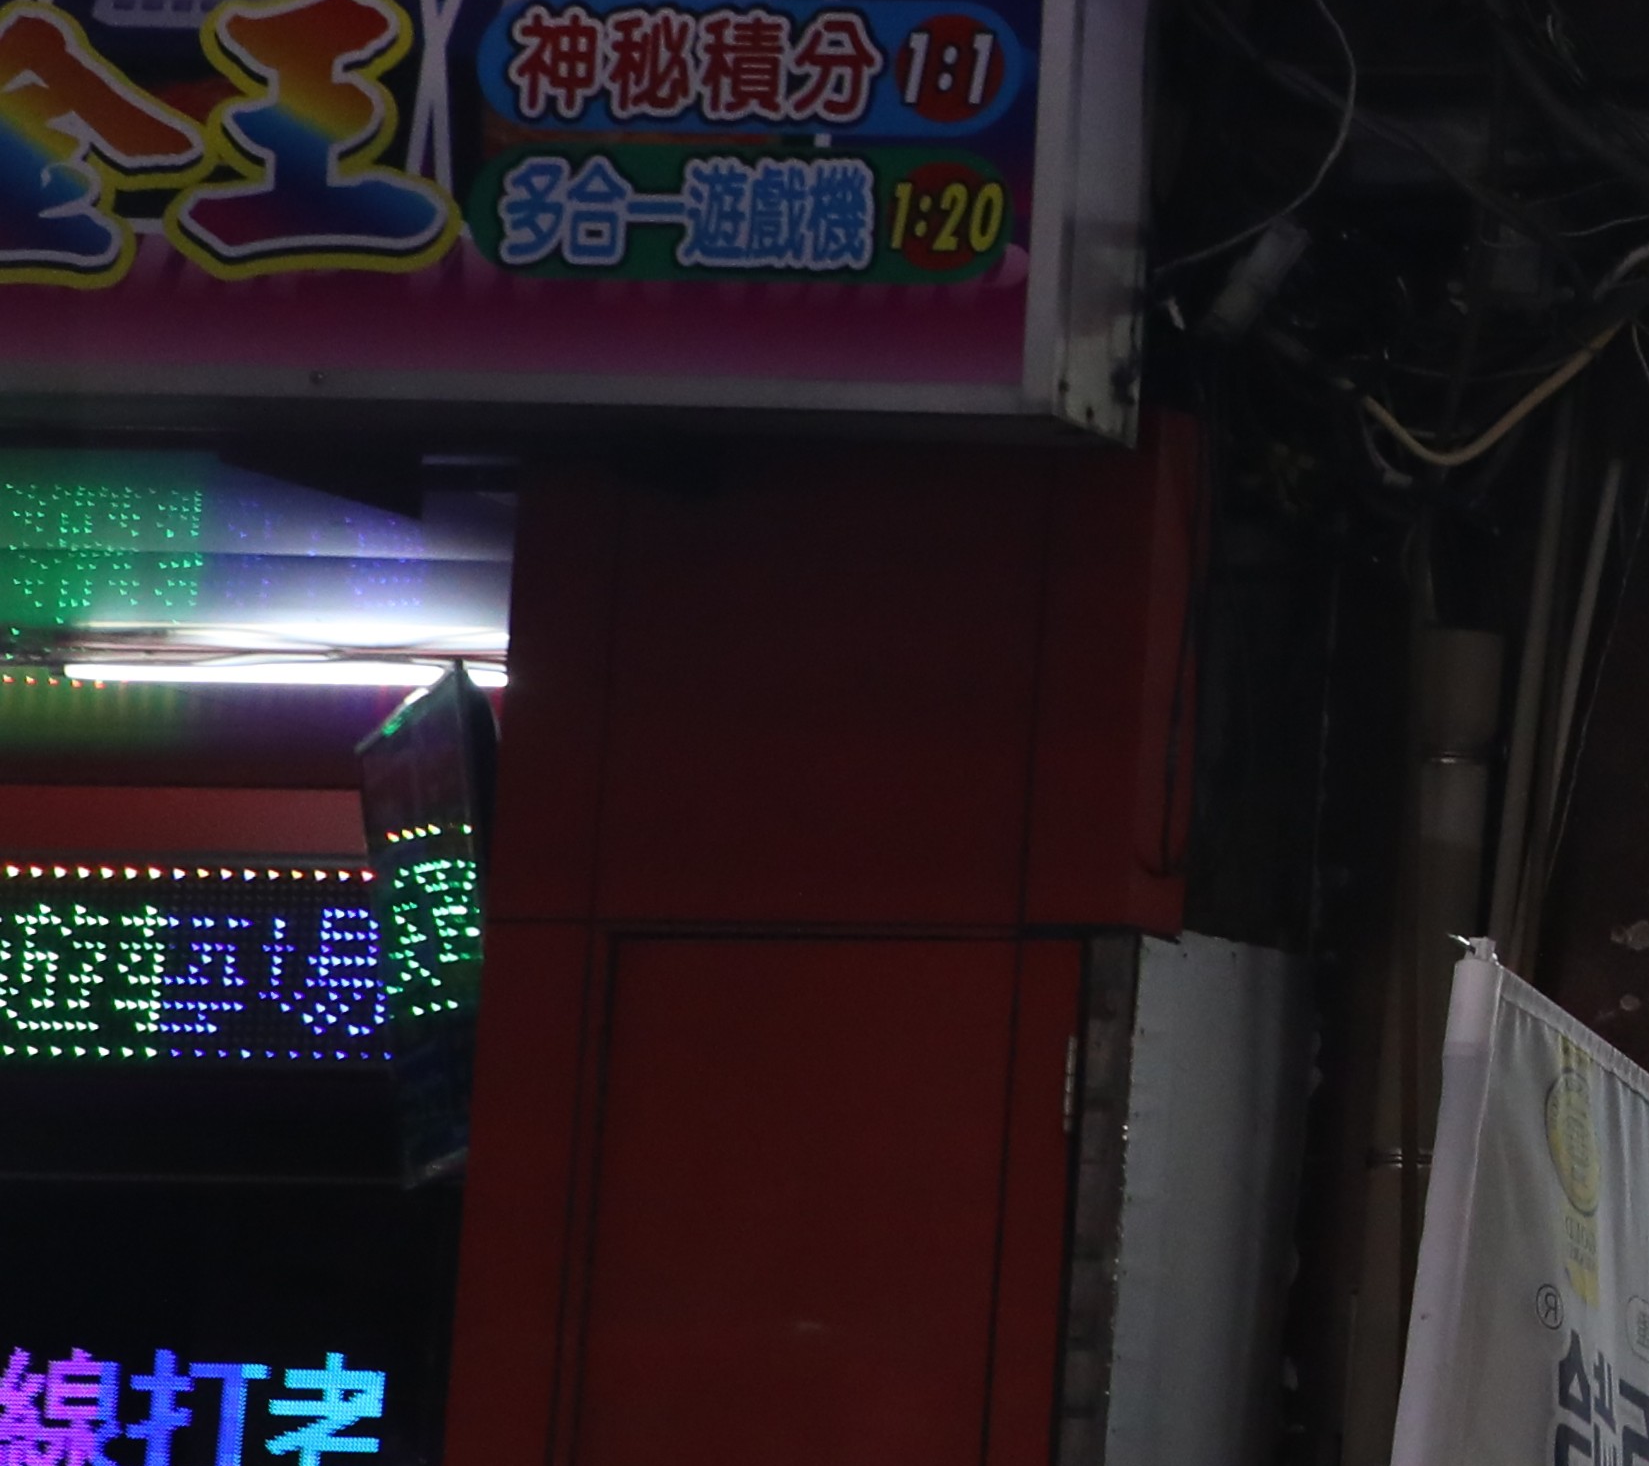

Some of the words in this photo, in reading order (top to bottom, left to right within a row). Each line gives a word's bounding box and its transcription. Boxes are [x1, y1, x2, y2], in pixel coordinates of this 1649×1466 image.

[510, 6, 880, 117] 神秘積分
[901, 30, 992, 108] 1:1
[500, 160, 875, 266] 多合一遊戲機
[892, 181, 1003, 256] 1:20
